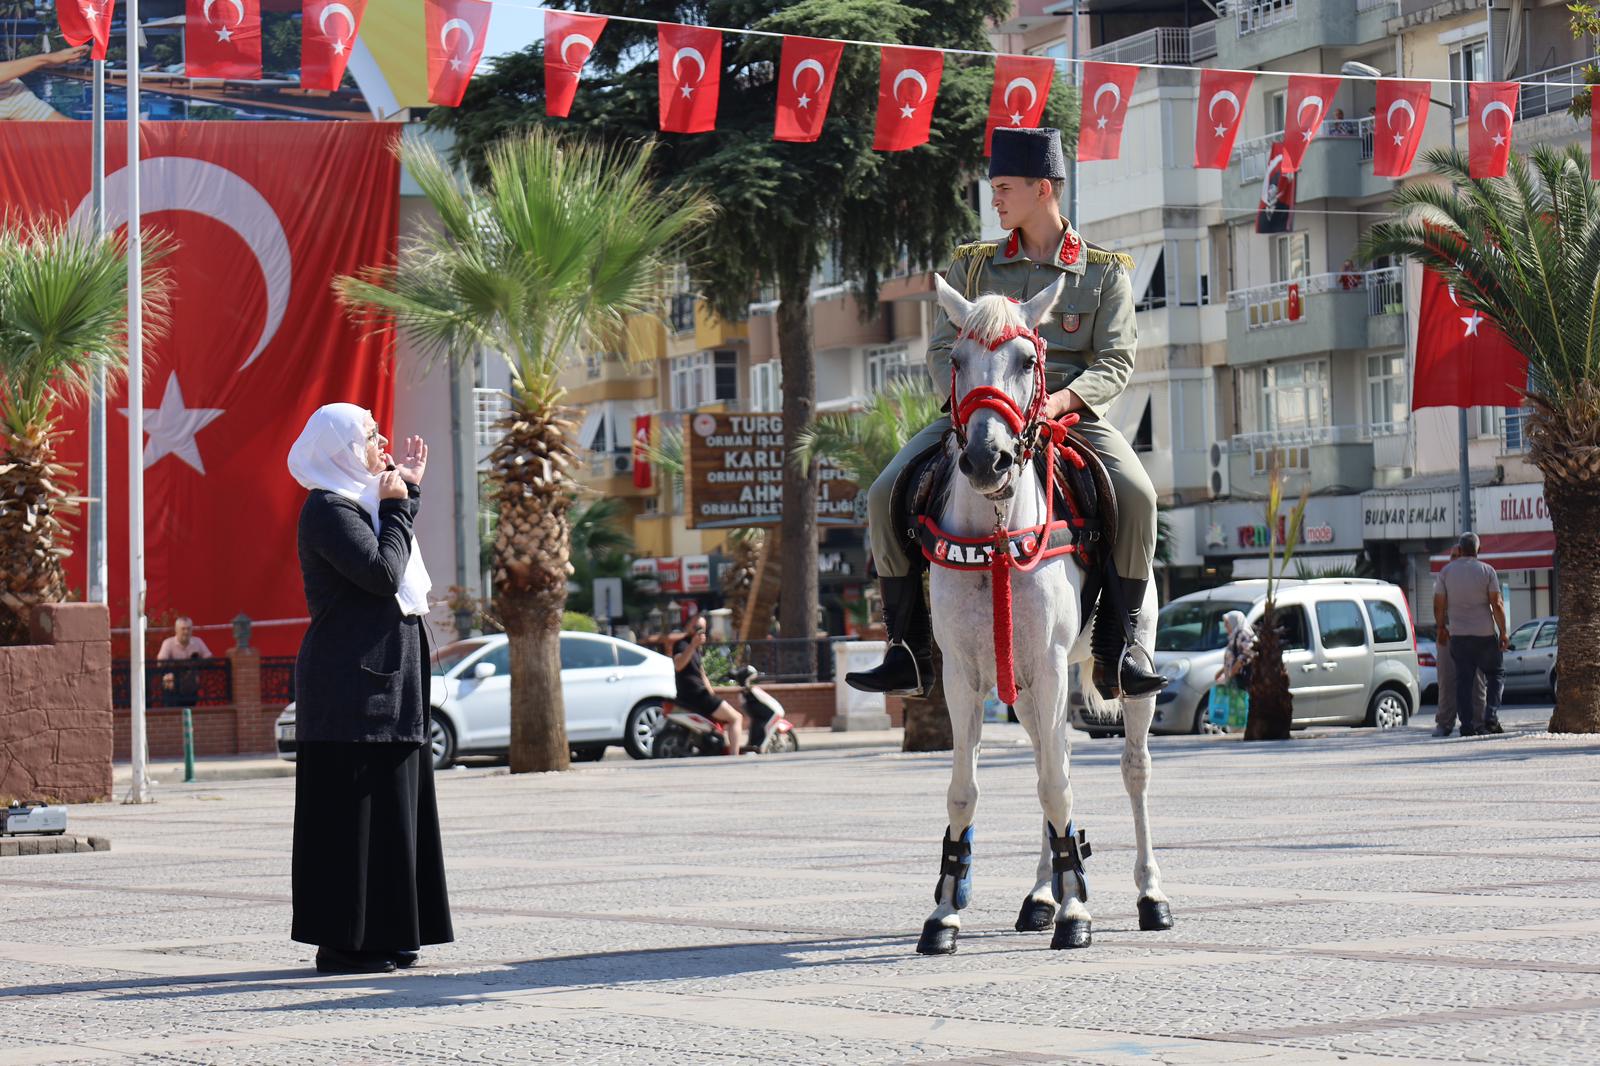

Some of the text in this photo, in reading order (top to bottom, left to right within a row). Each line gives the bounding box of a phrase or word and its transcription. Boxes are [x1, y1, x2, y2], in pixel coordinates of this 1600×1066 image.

[729, 416, 784, 433] TURG
[706, 434, 784, 448] ORMAN İŞLE
[707, 471, 754, 483] ORMAN
[758, 471, 784, 483] İŞLE
[702, 499, 853, 516] ORMAN İŞLET EFLİĞİ
[1365, 508, 1405, 525] BULVAR
[1408, 506, 1446, 524] EMLAK
[1501, 493, 1533, 521] HİLAL
